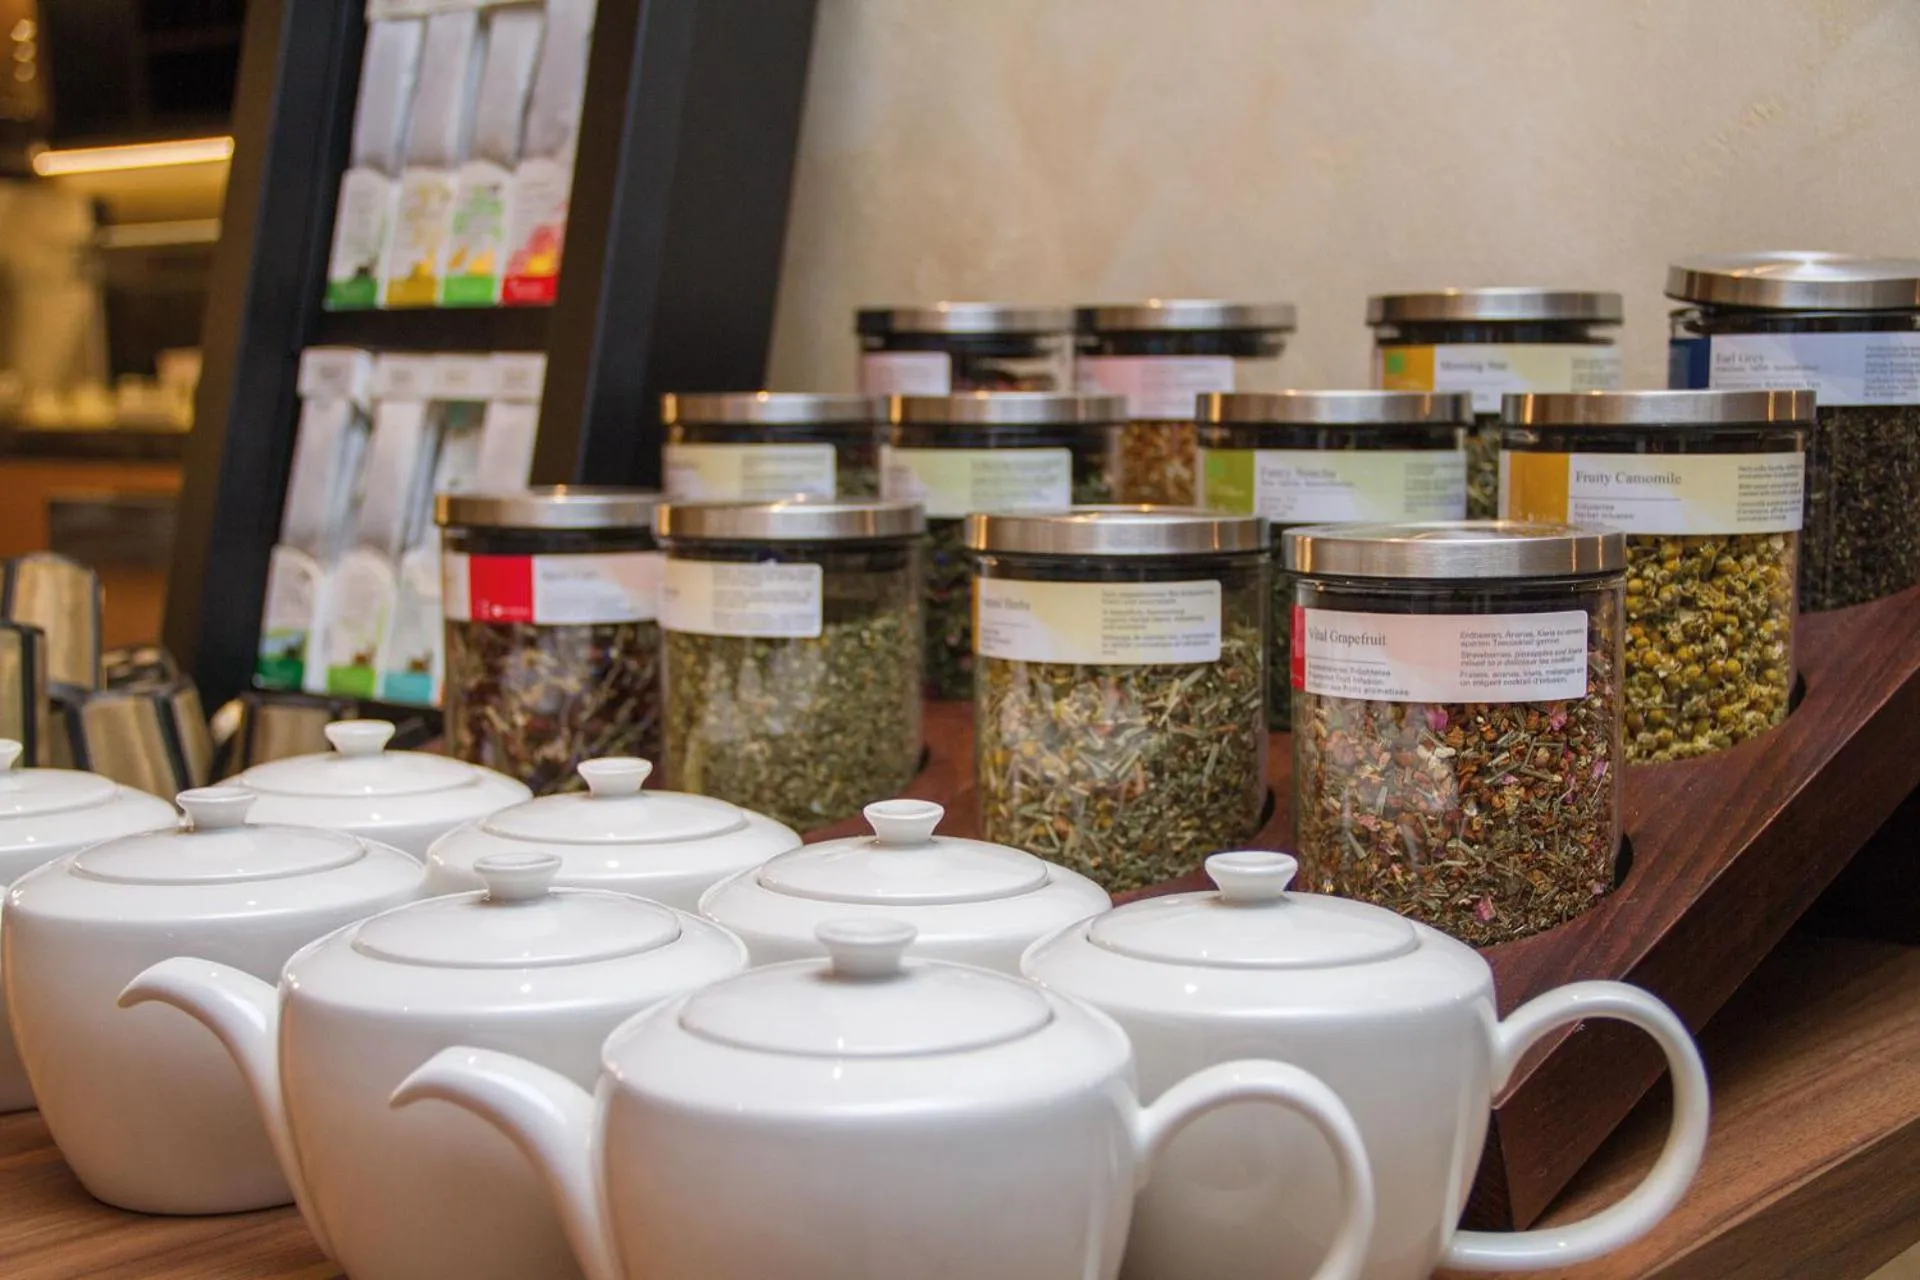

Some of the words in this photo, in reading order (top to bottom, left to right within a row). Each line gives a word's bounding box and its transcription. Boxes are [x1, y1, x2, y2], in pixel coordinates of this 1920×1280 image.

[1575, 470, 1611, 487] Fruity
[1615, 472, 1682, 485] Camomile
[1308, 626, 1328, 642] Vital
[1329, 630, 1386, 648] Grapefruit
